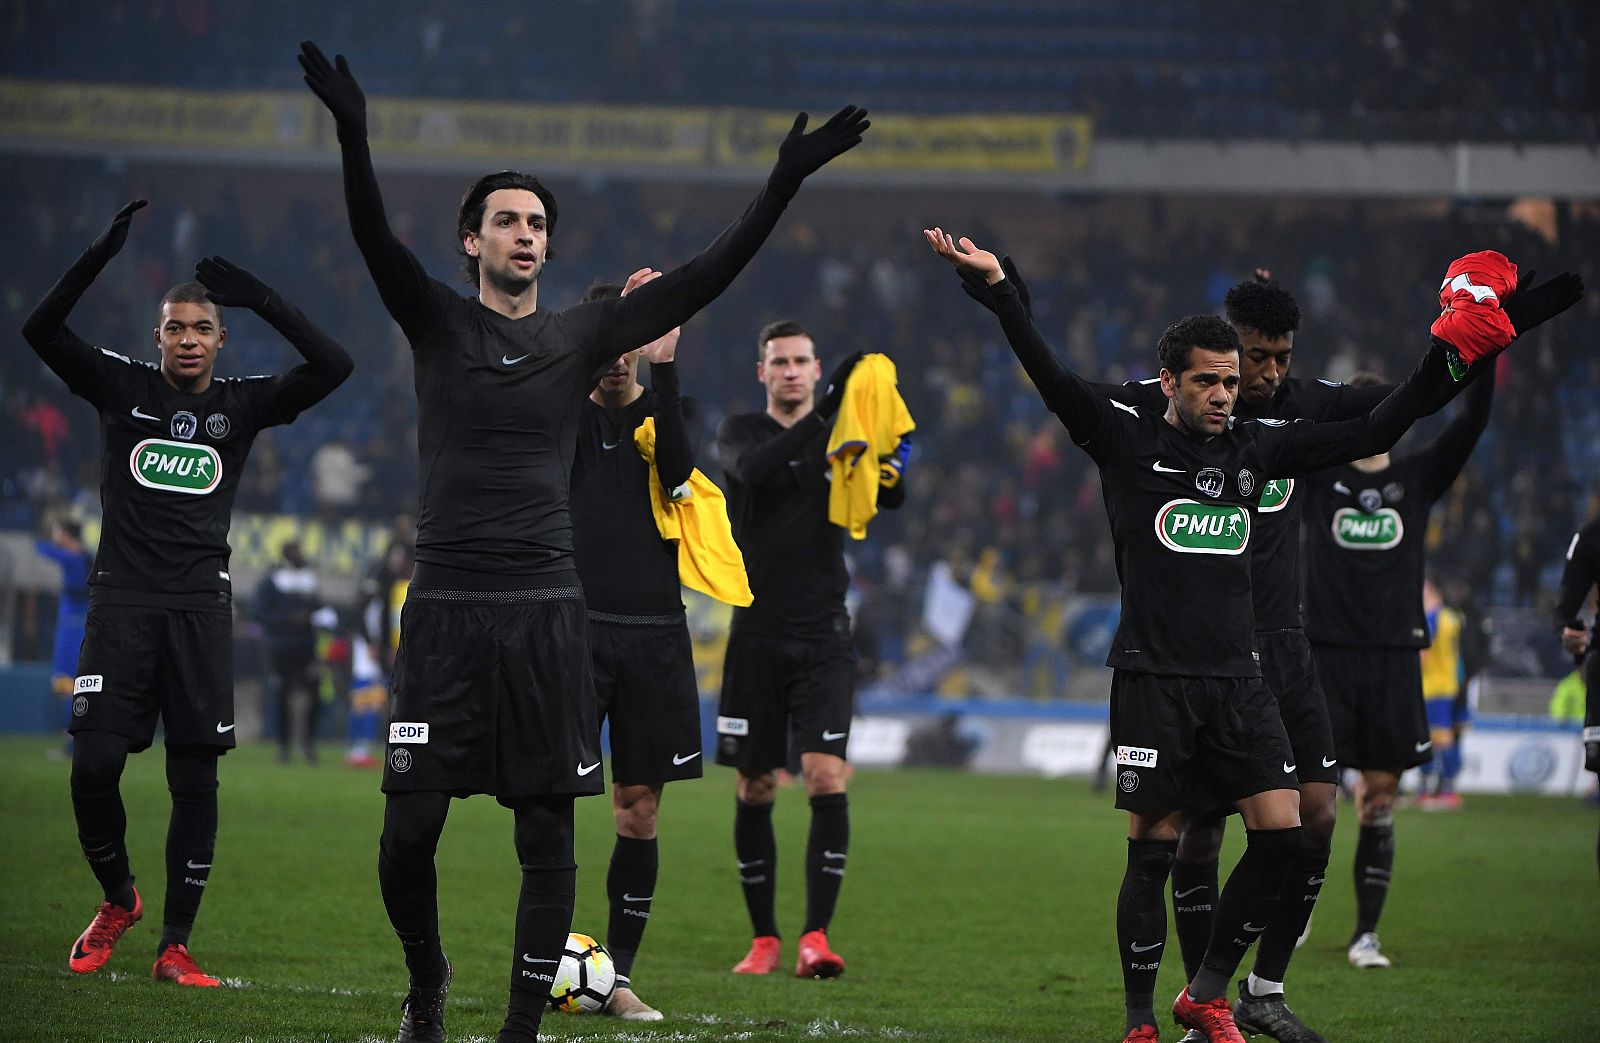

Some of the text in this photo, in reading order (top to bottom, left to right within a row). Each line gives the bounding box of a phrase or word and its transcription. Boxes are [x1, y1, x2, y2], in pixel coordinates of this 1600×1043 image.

[142, 450, 195, 476] PMU
[1171, 513, 1226, 536] PMU
[1340, 517, 1380, 538] PMU
[79, 678, 100, 688] eDF
[398, 726, 425, 738] eDF
[1129, 750, 1155, 763] eDF
[1177, 904, 1212, 913] PARIS
[522, 969, 554, 983] PARIS
